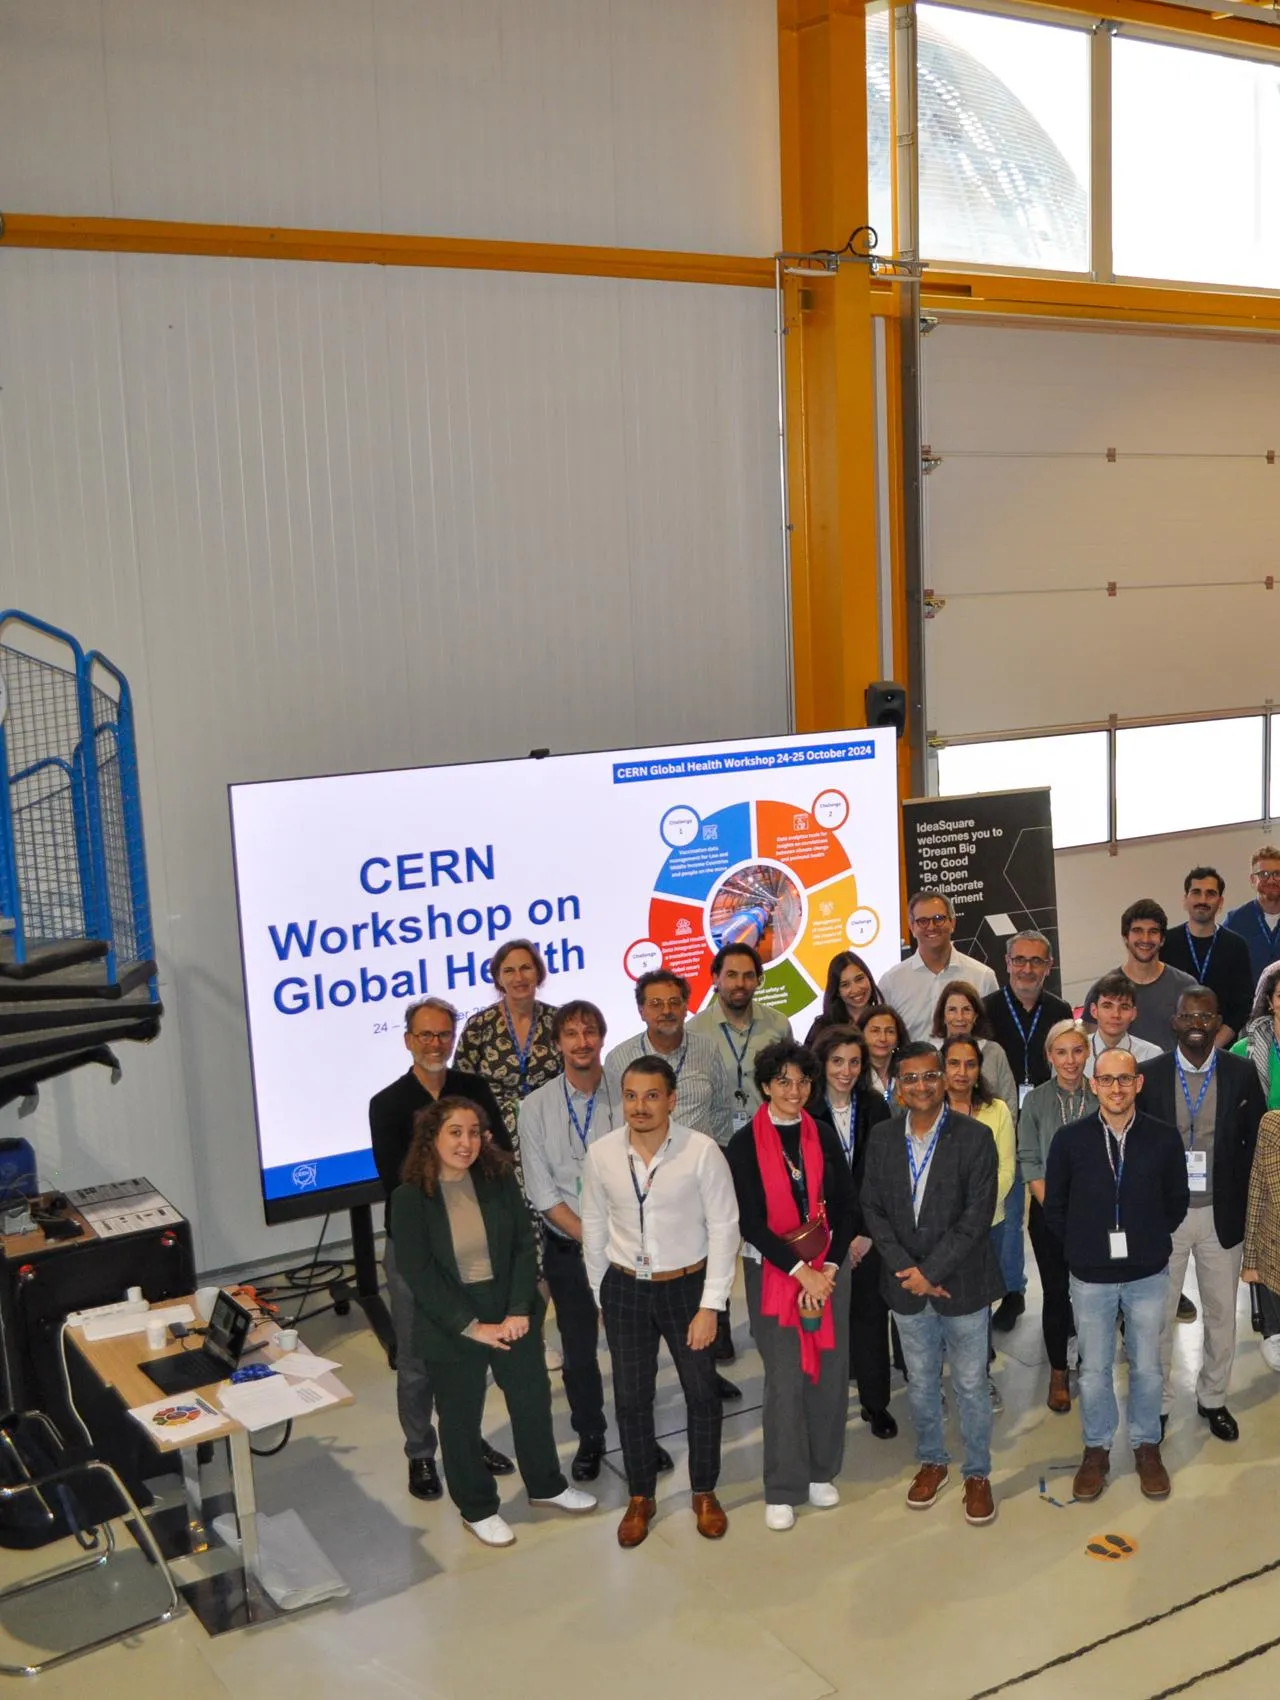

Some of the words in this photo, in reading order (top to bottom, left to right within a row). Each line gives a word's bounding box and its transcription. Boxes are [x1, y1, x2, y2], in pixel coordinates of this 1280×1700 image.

[616, 766, 648, 778] CERN
[650, 763, 685, 776] Global
[687, 760, 722, 772] Health
[724, 755, 776, 768] Workshop
[777, 751, 805, 763] 24-25
[806, 748, 847, 760] October
[847, 745, 872, 757] 2024
[916, 818, 976, 834] IdeaSquare
[917, 831, 970, 846] welcomes
[971, 830, 991, 843] you
[992, 828, 1003, 837] to
[959, 843, 977, 855] Big
[360, 845, 495, 895] CERN
[940, 856, 969, 868] Good
[940, 869, 969, 883] Open
[268, 905, 512, 960] Workshop
[527, 895, 580, 926] on
[273, 960, 428, 1014] Global
[373, 1021, 389, 1035] 24
